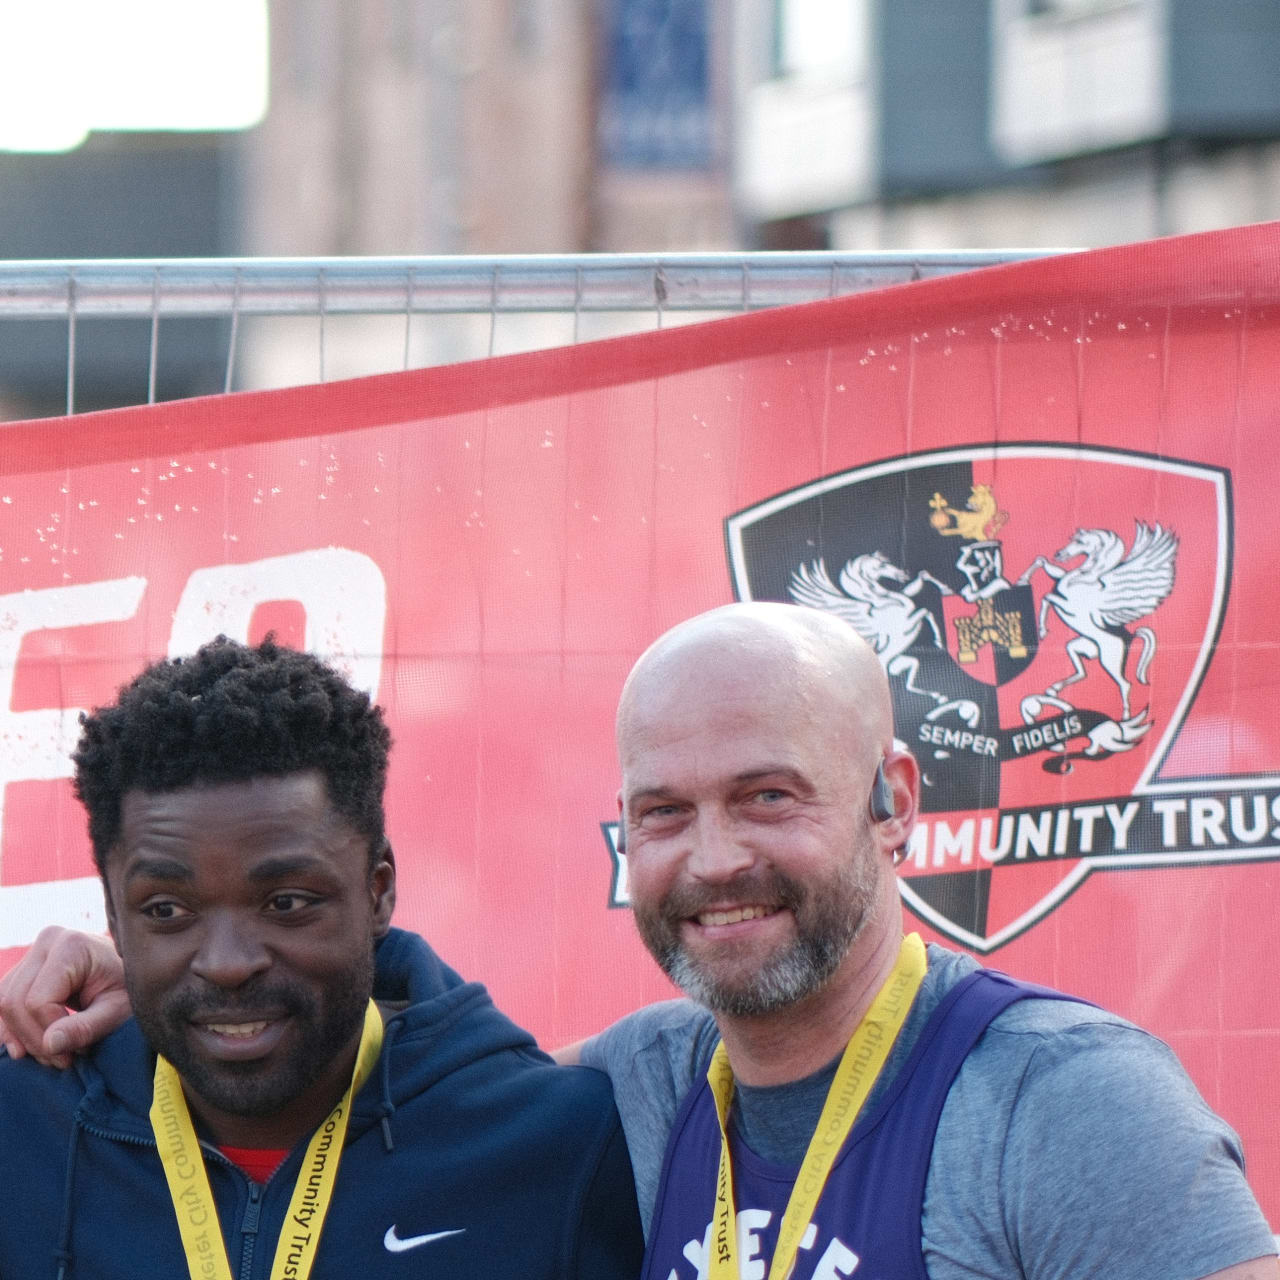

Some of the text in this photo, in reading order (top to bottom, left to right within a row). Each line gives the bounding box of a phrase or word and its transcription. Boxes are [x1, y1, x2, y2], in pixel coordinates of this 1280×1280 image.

[918, 715, 1082, 757] SEMPER FIDELIS
[903, 795, 1280, 868] MMUNITY TRU
[292, 1108, 343, 1230] Community
[718, 1204, 731, 1264] Trust
